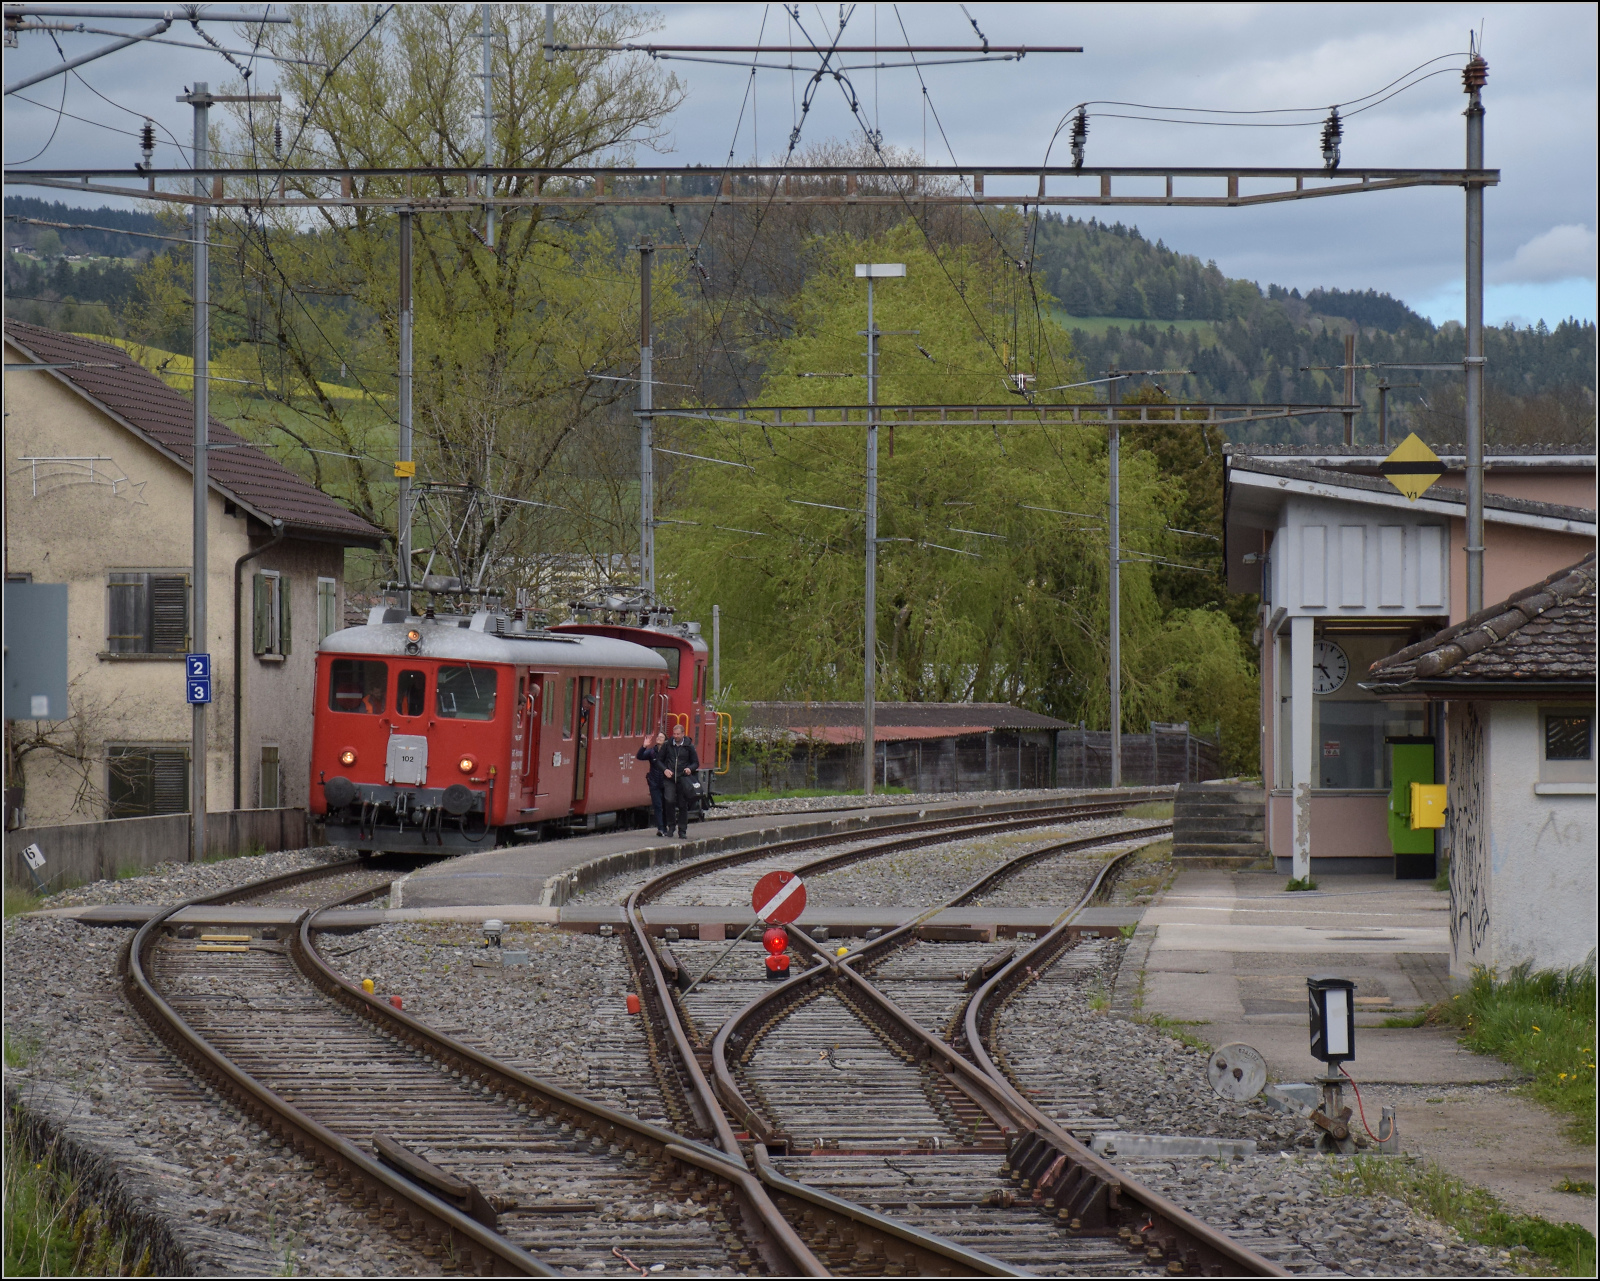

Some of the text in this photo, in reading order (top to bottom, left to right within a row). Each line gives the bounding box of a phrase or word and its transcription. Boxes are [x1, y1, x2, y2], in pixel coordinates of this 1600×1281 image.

[194, 662, 203, 674] 2
[194, 686, 204, 699] 3
[25, 848, 35, 859] 6
